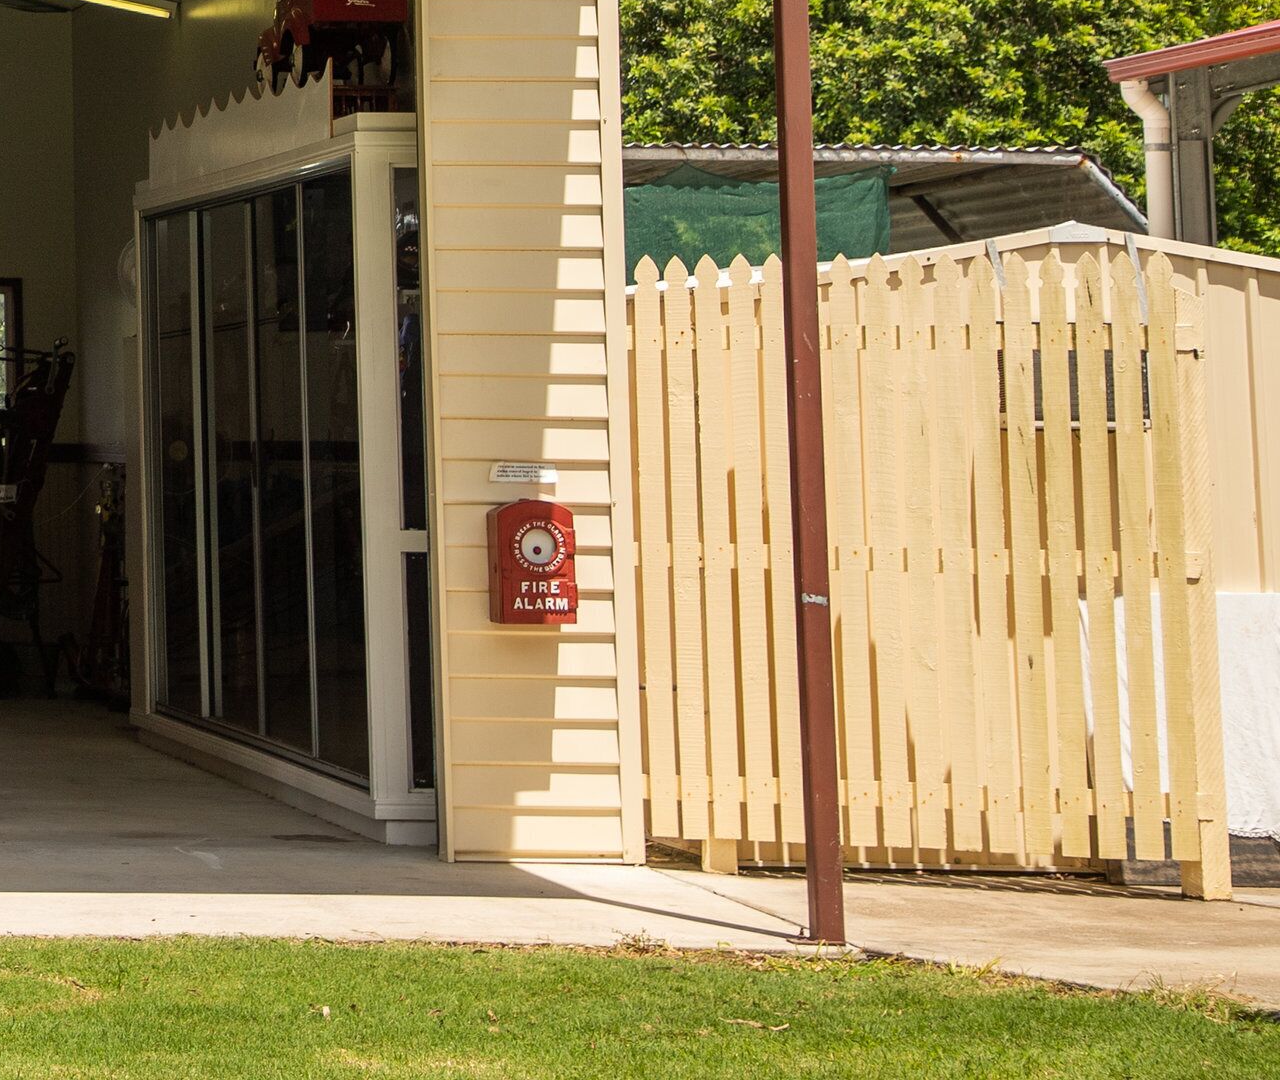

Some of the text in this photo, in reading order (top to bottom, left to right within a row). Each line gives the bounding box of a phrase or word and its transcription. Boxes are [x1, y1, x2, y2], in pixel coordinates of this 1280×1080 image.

[515, 523, 531, 540] BREAK
[521, 581, 560, 594] FIRE
[513, 597, 569, 610] ALARM
